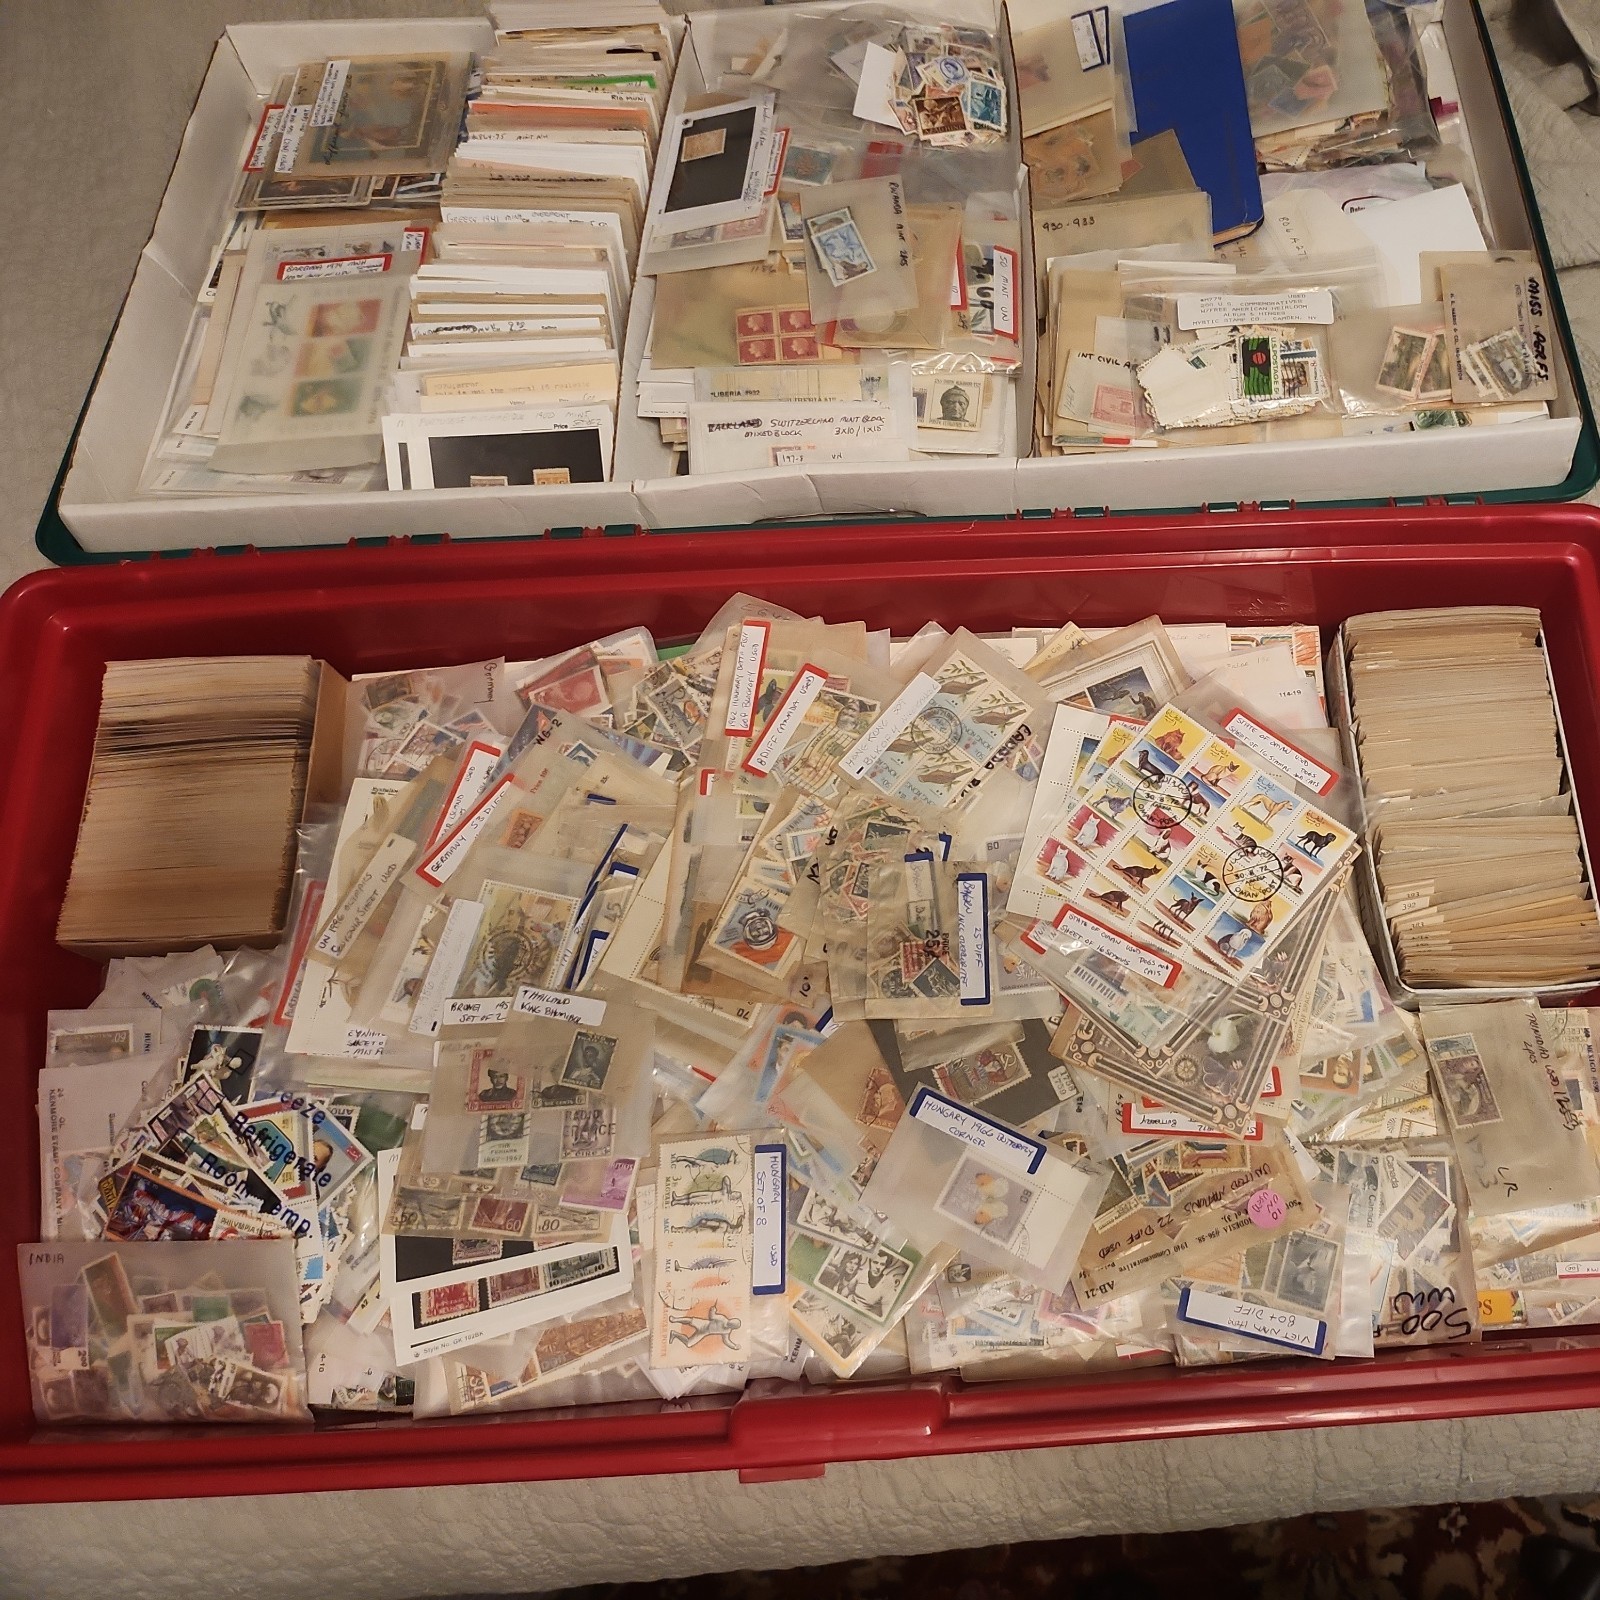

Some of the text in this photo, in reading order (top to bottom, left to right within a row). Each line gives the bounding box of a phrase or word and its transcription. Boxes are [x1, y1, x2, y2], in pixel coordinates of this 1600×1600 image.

[1077, 352, 1121, 366] INT CIVIL
[474, 662, 497, 705] Germany
[1235, 717, 1258, 734] STATE
[430, 833, 466, 874] GERMANY
[987, 841, 1000, 851] 60
[1401, 902, 1416, 911] 392
[1091, 925, 1100, 933] OF
[317, 934, 333, 950] UN
[942, 932, 950, 956] PRICE
[1084, 938, 1095, 946] OF
[975, 941, 984, 970] DIFF
[520, 1003, 542, 1015] KING
[460, 1013, 477, 1023] SET
[1586, 1044, 1598, 1073] MEXICO
[922, 1100, 967, 1127] HUNGARY
[948, 1126, 987, 1149] CORNER
[232, 1113, 334, 1189] Refrigerate
[269, 1201, 314, 1240] emp.
[505, 1219, 521, 1231] 60
[28, 1252, 65, 1265] INDIA
[1084, 1280, 1116, 1300] AB-21
[1233, 1303, 1266, 1319] DIFF
